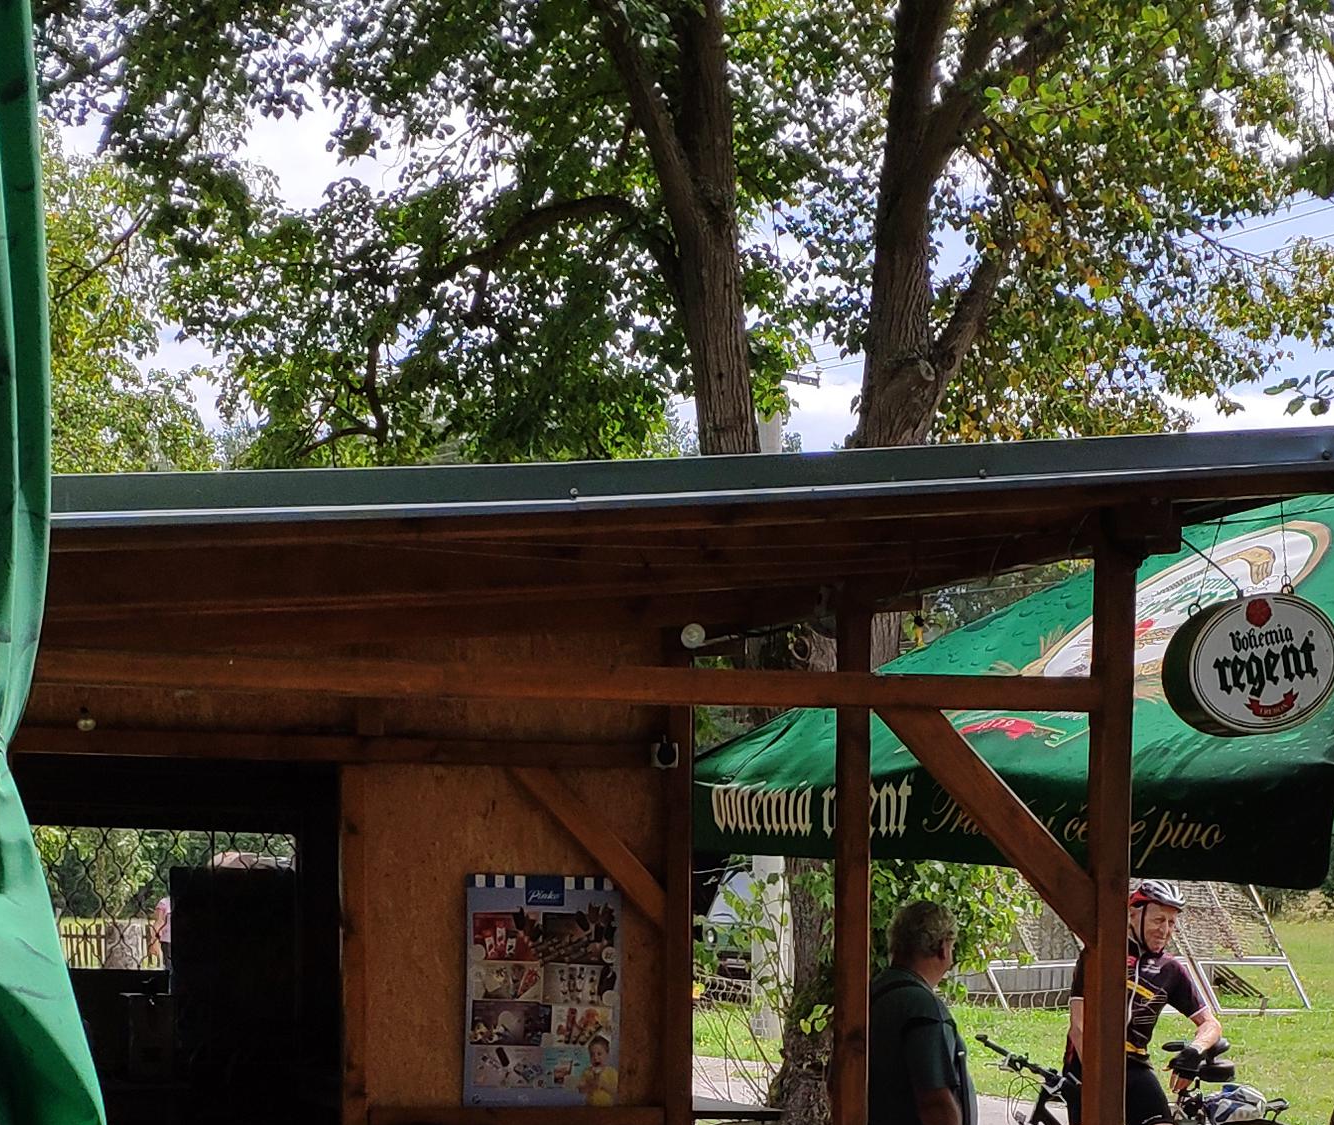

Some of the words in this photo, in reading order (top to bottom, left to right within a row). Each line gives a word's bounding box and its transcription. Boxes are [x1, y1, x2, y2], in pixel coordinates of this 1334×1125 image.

[1213, 637, 1318, 698] regent
[1229, 624, 1294, 653] Bohemia
[1135, 810, 1226, 869] pivo
